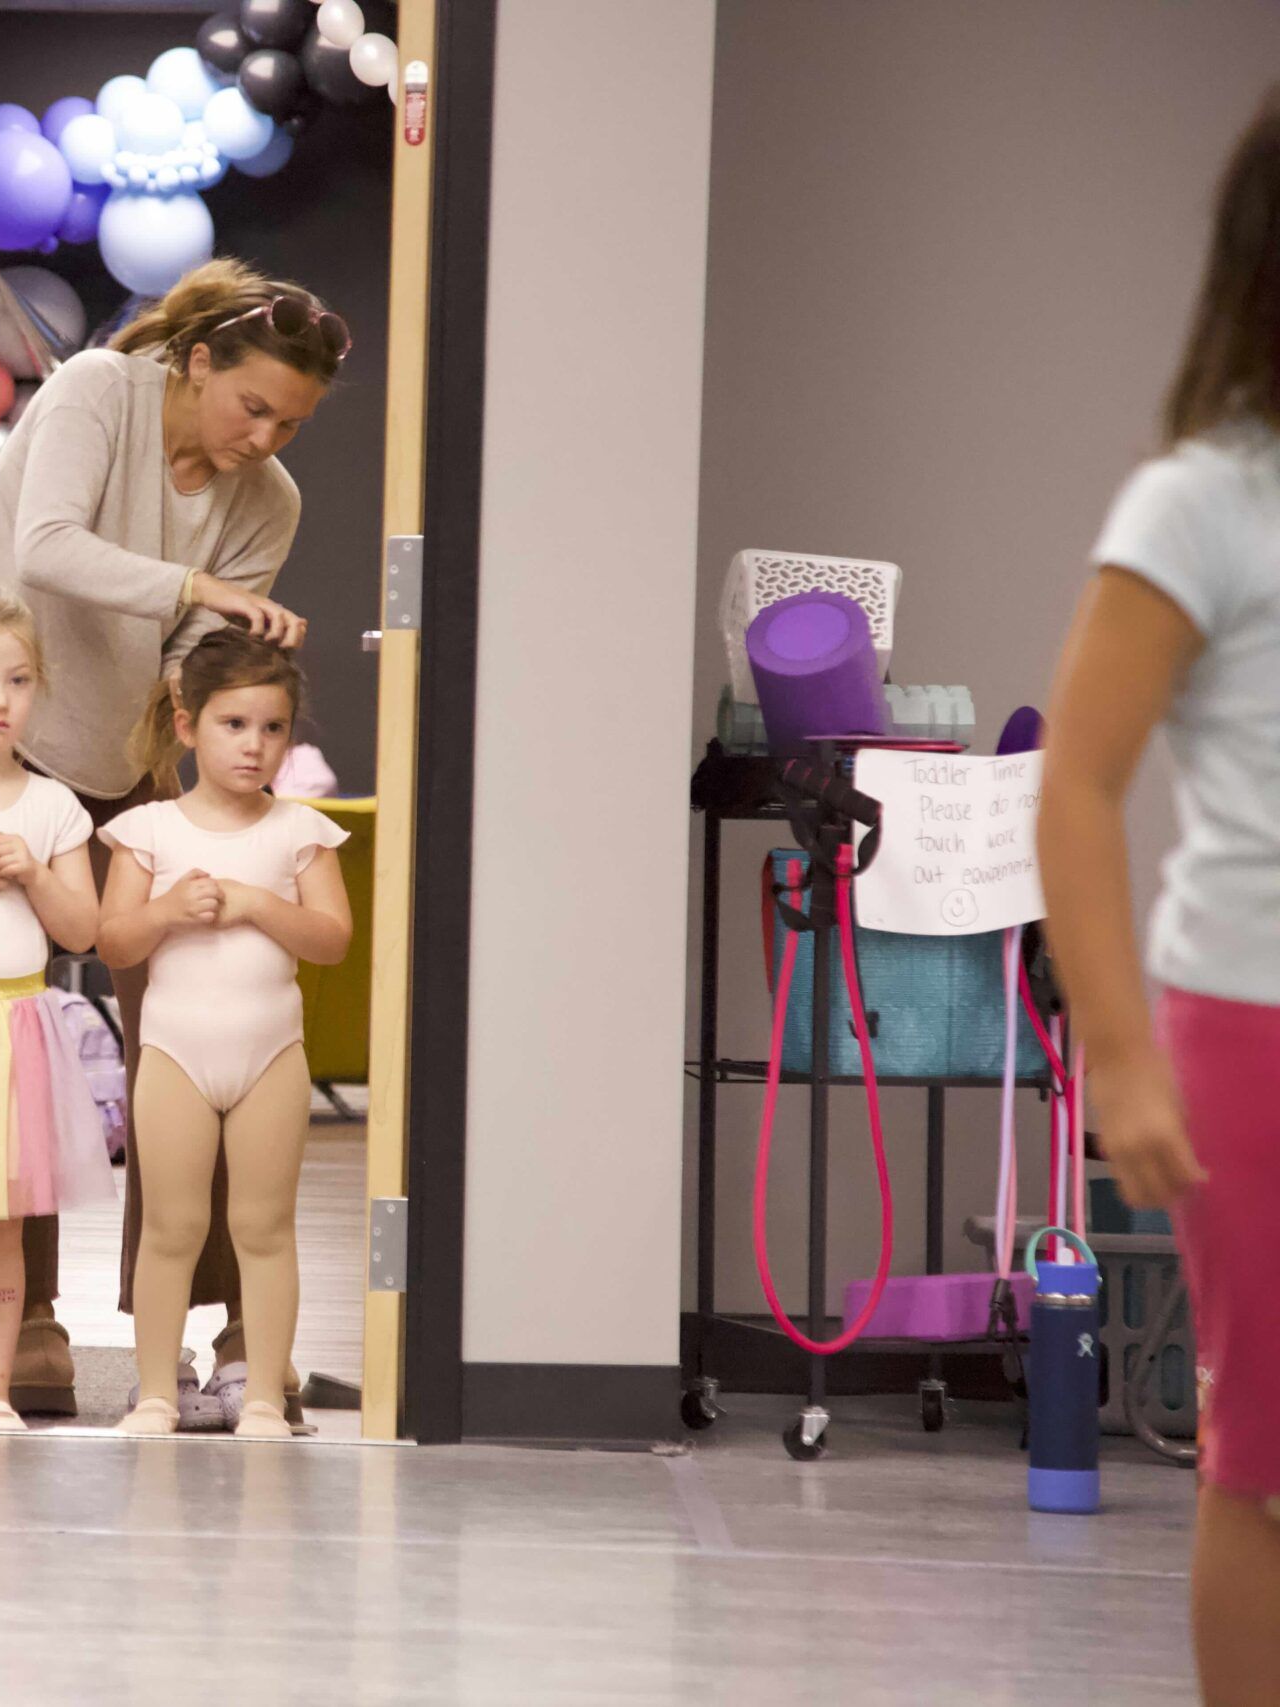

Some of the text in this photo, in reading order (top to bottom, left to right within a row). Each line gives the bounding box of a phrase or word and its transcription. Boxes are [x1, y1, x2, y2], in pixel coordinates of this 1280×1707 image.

[904, 759, 1026, 785] Toddler Time
[920, 794, 973, 822] Please
[989, 793, 1009, 817] do
[914, 828, 1018, 854] touch work
